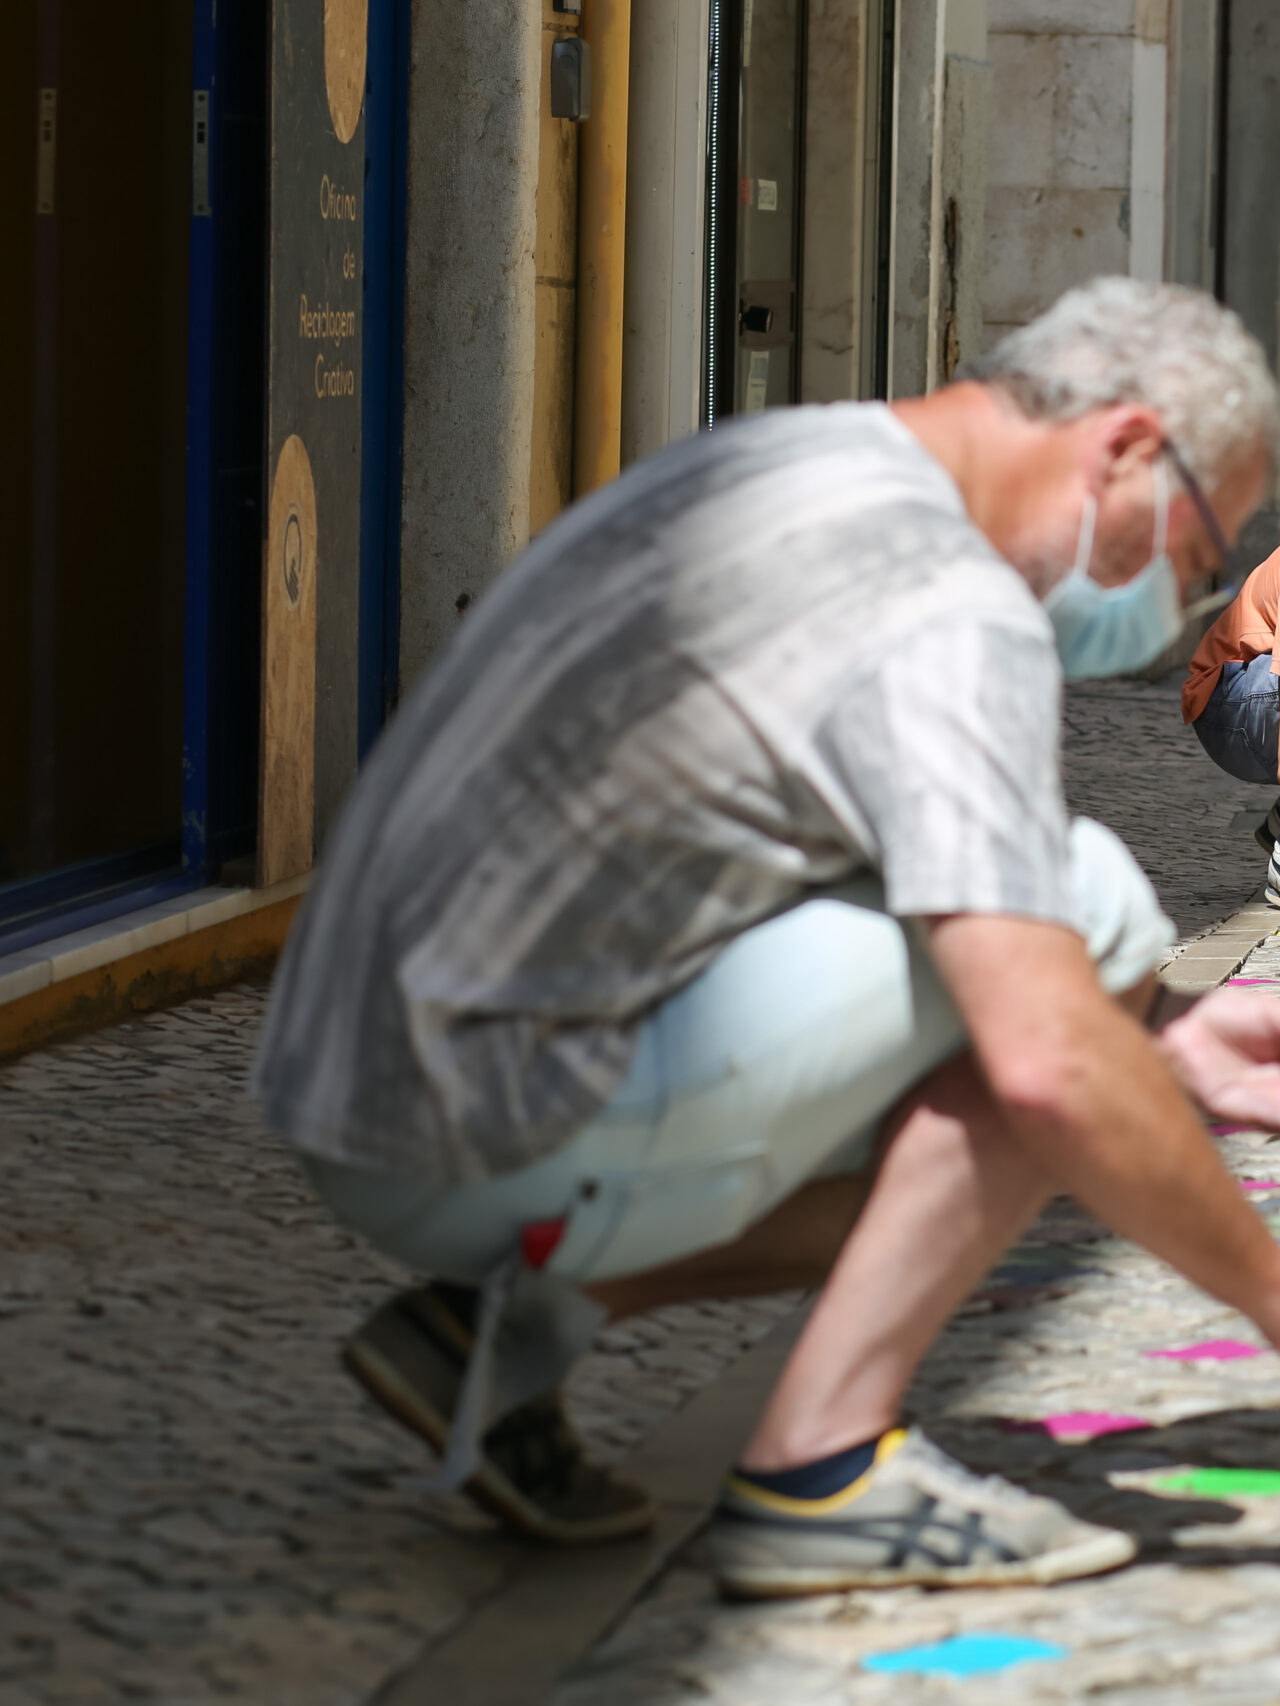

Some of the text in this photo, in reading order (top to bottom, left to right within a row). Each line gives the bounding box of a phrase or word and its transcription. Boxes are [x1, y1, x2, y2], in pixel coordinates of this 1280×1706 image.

[320, 174, 356, 221] Oficina
[343, 245, 355, 279] de
[300, 294, 355, 347] Reciclagem
[314, 353, 354, 398] Criativa
